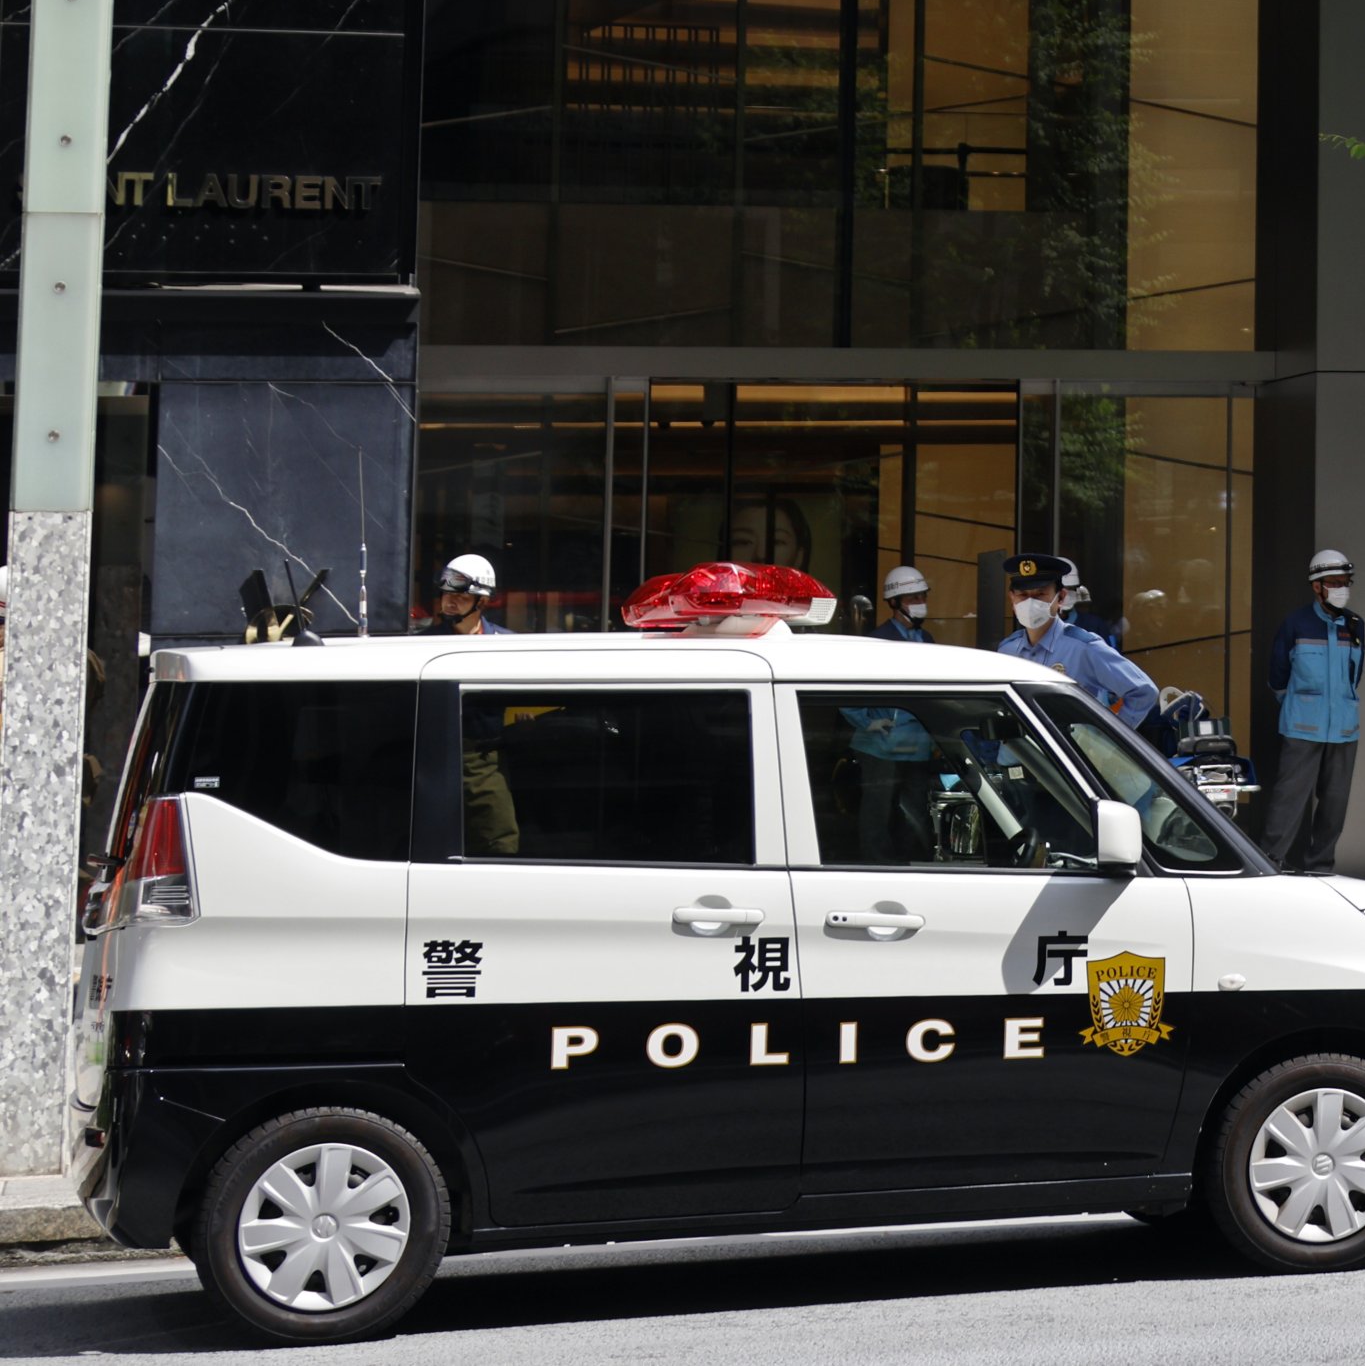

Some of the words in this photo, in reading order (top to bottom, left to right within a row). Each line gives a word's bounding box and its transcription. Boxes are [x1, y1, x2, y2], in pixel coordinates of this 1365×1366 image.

[166, 172, 383, 211] LAURENT
[422, 930, 1089, 998] 警視庁
[1096, 965, 1157, 982] POLICE
[551, 1019, 1045, 1070] POLICE
